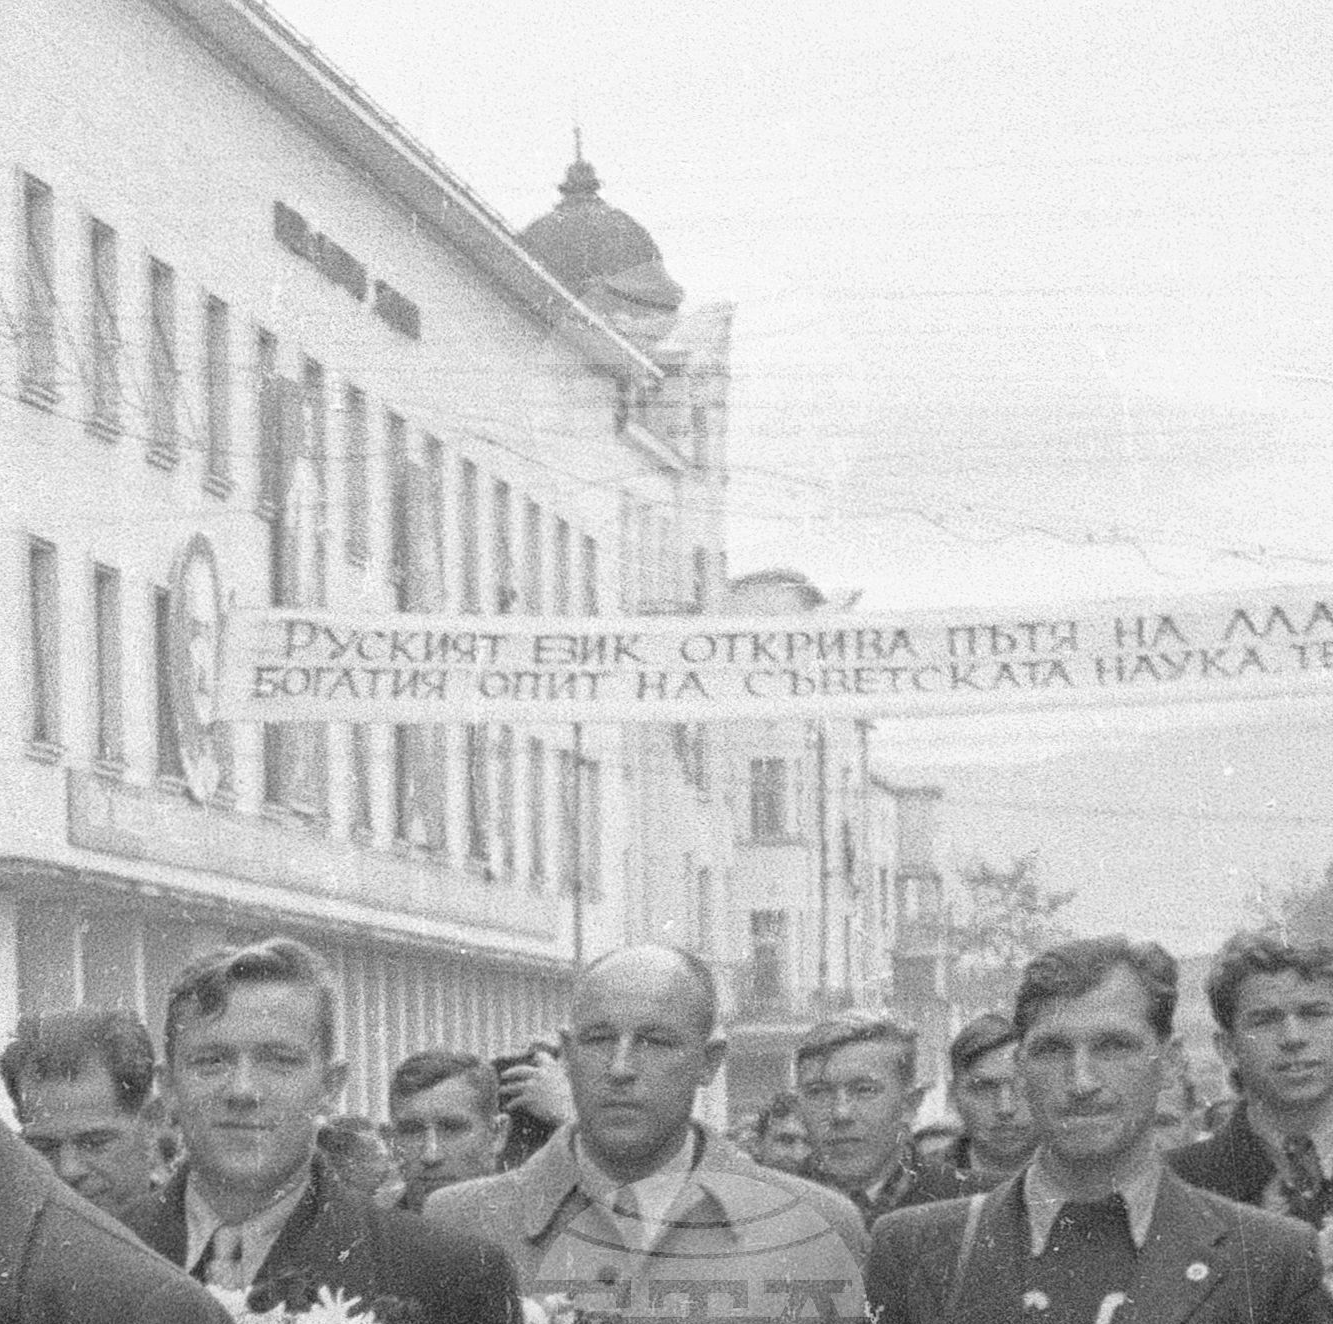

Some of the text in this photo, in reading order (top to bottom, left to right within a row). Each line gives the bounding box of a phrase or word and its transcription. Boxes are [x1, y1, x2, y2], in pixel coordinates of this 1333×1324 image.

[284, 618, 506, 662] РУСКИЯТ
[533, 633, 644, 664] ЕЗИК
[678, 628, 918, 663] ОТКРИВА
[946, 621, 1078, 657] ПЪТЯ
[1114, 615, 1188, 649] НА
[253, 666, 448, 700] БОГАТИЯ
[478, 670, 608, 700] ОПИТ
[636, 671, 713, 700] НА
[744, 660, 1075, 698] СЪВЕТСКАТА
